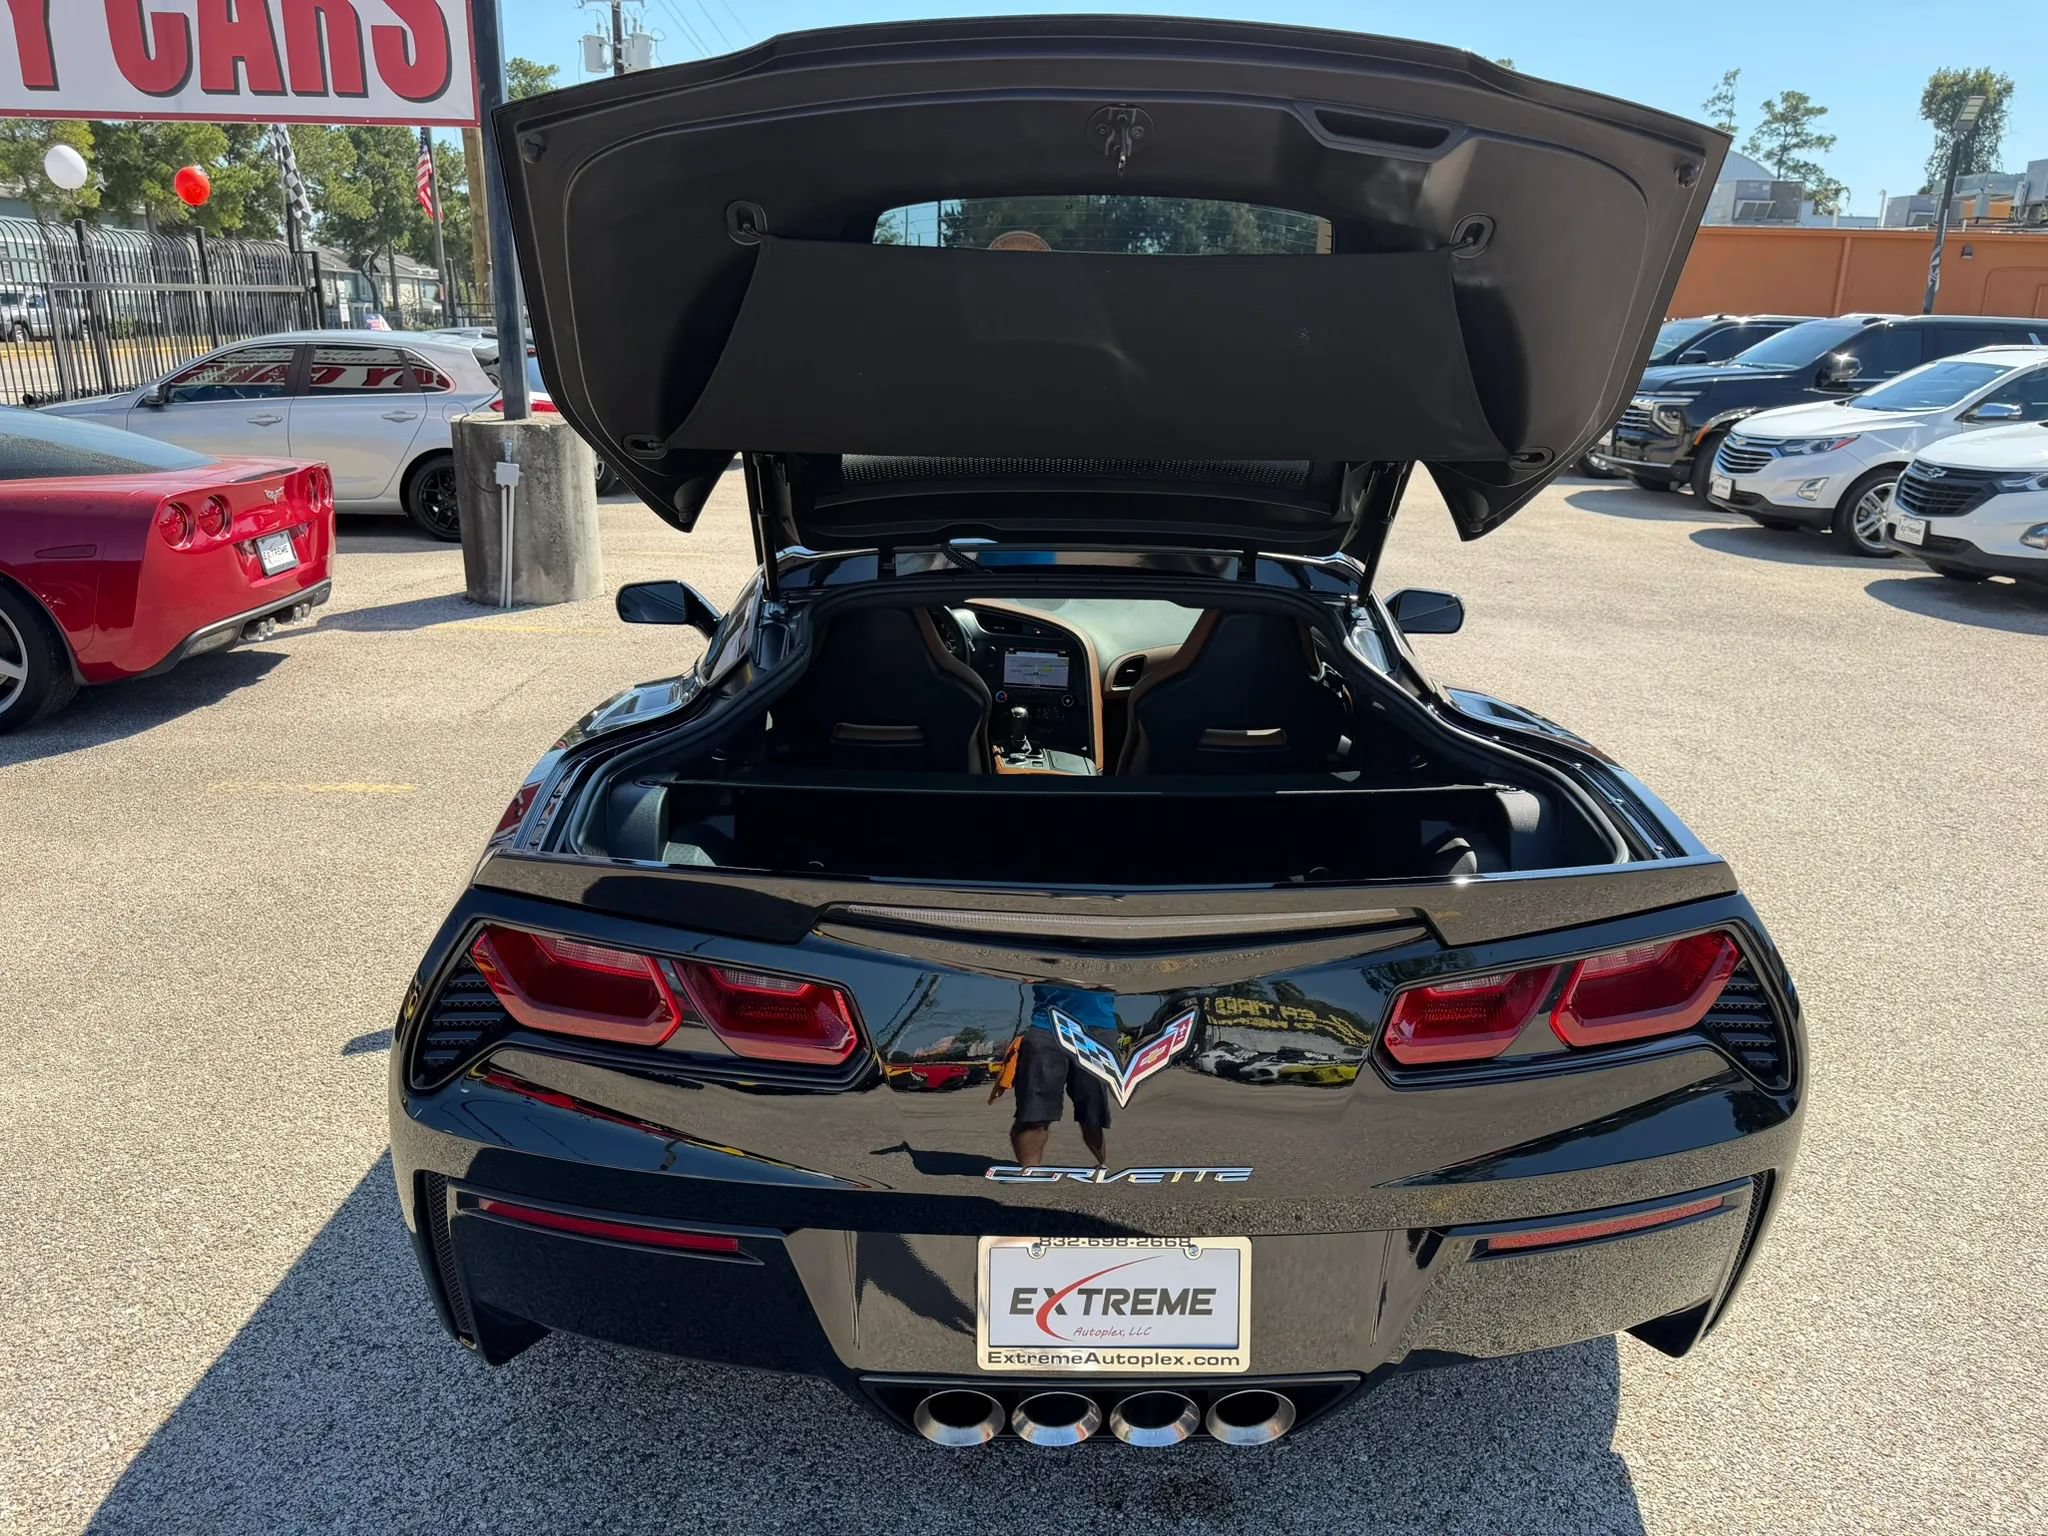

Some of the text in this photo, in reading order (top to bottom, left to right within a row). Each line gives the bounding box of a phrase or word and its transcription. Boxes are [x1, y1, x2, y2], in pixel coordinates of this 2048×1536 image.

[103, 0, 453, 102] CARS
[984, 1165, 1254, 1184] CORVETTE
[1009, 1287, 1217, 1316] EXTREME
[1072, 1326, 1153, 1340] Autoplex, LLC
[987, 1351, 1240, 1368] ExtremeAutoplex.com
